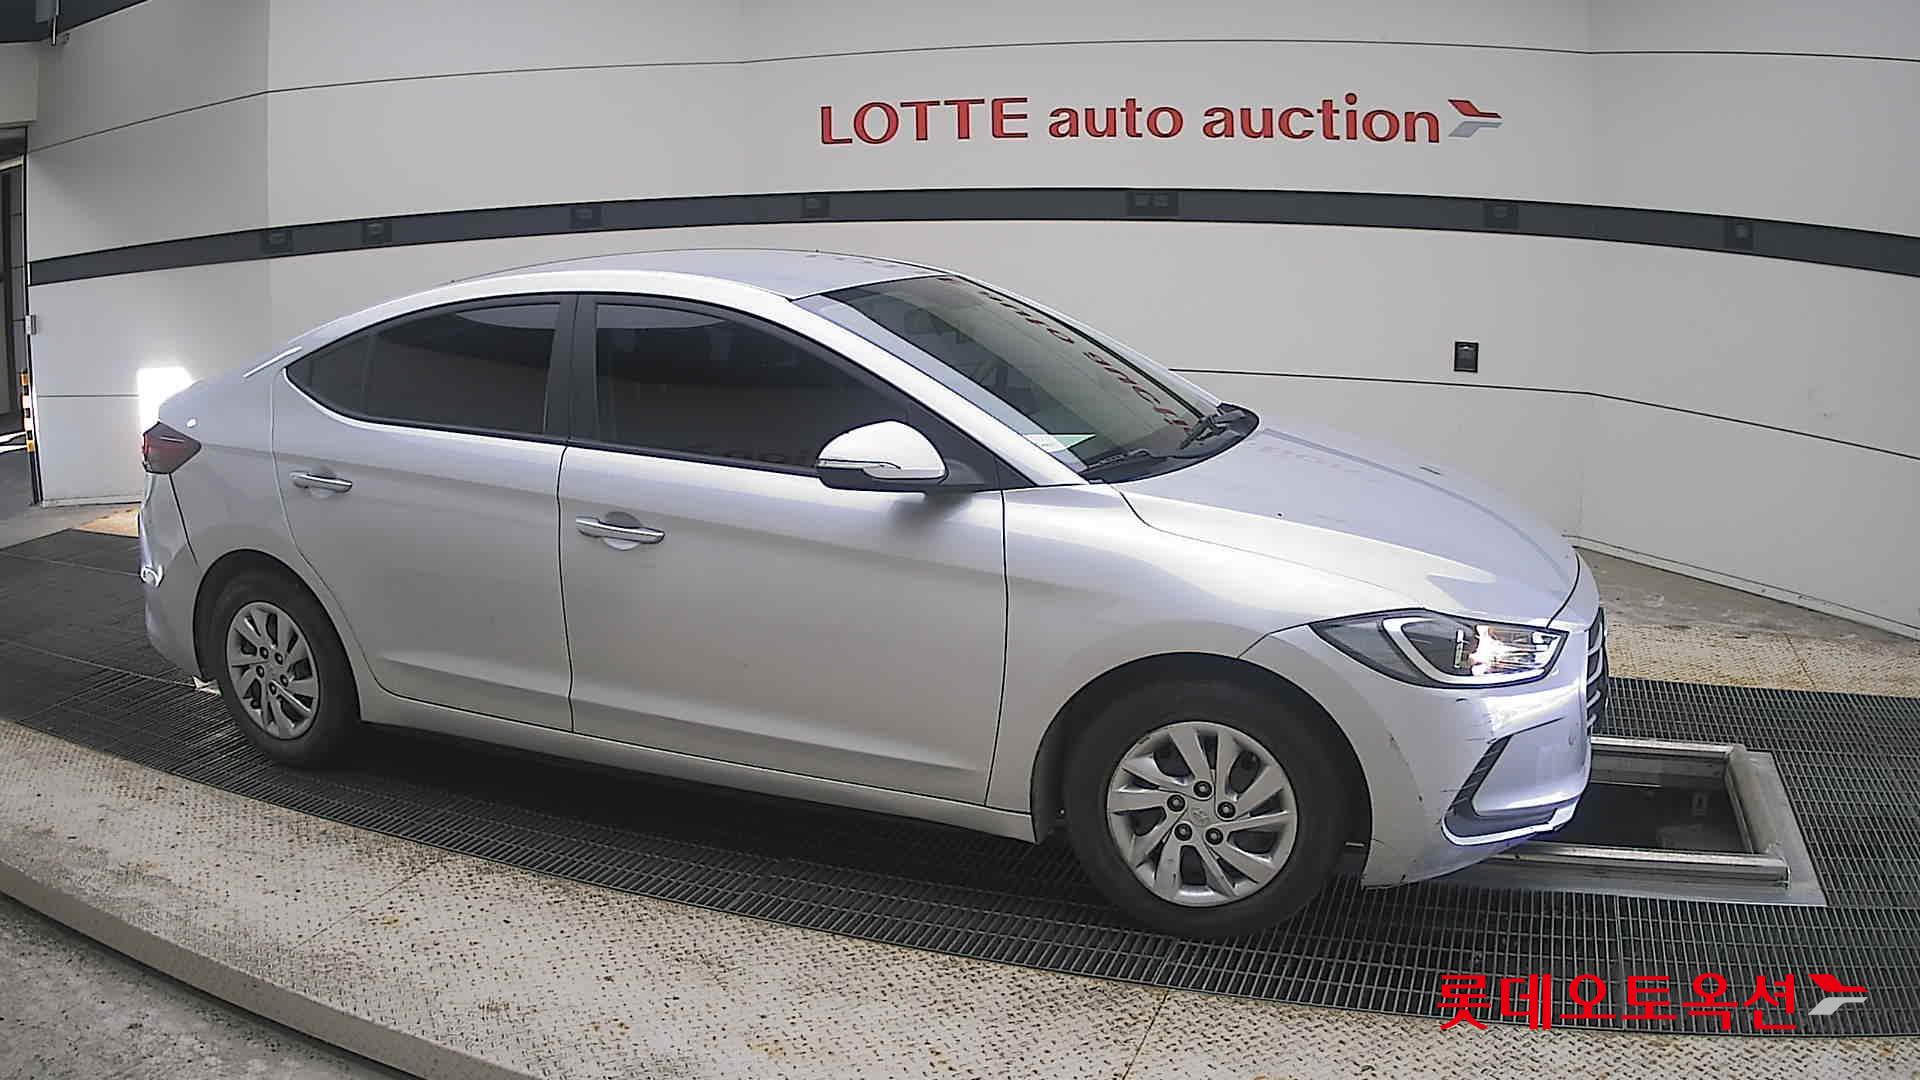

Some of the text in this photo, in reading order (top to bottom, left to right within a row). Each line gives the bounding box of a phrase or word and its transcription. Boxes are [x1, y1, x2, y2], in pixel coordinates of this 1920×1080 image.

[820, 93, 1441, 145] LOTTE auto auction
